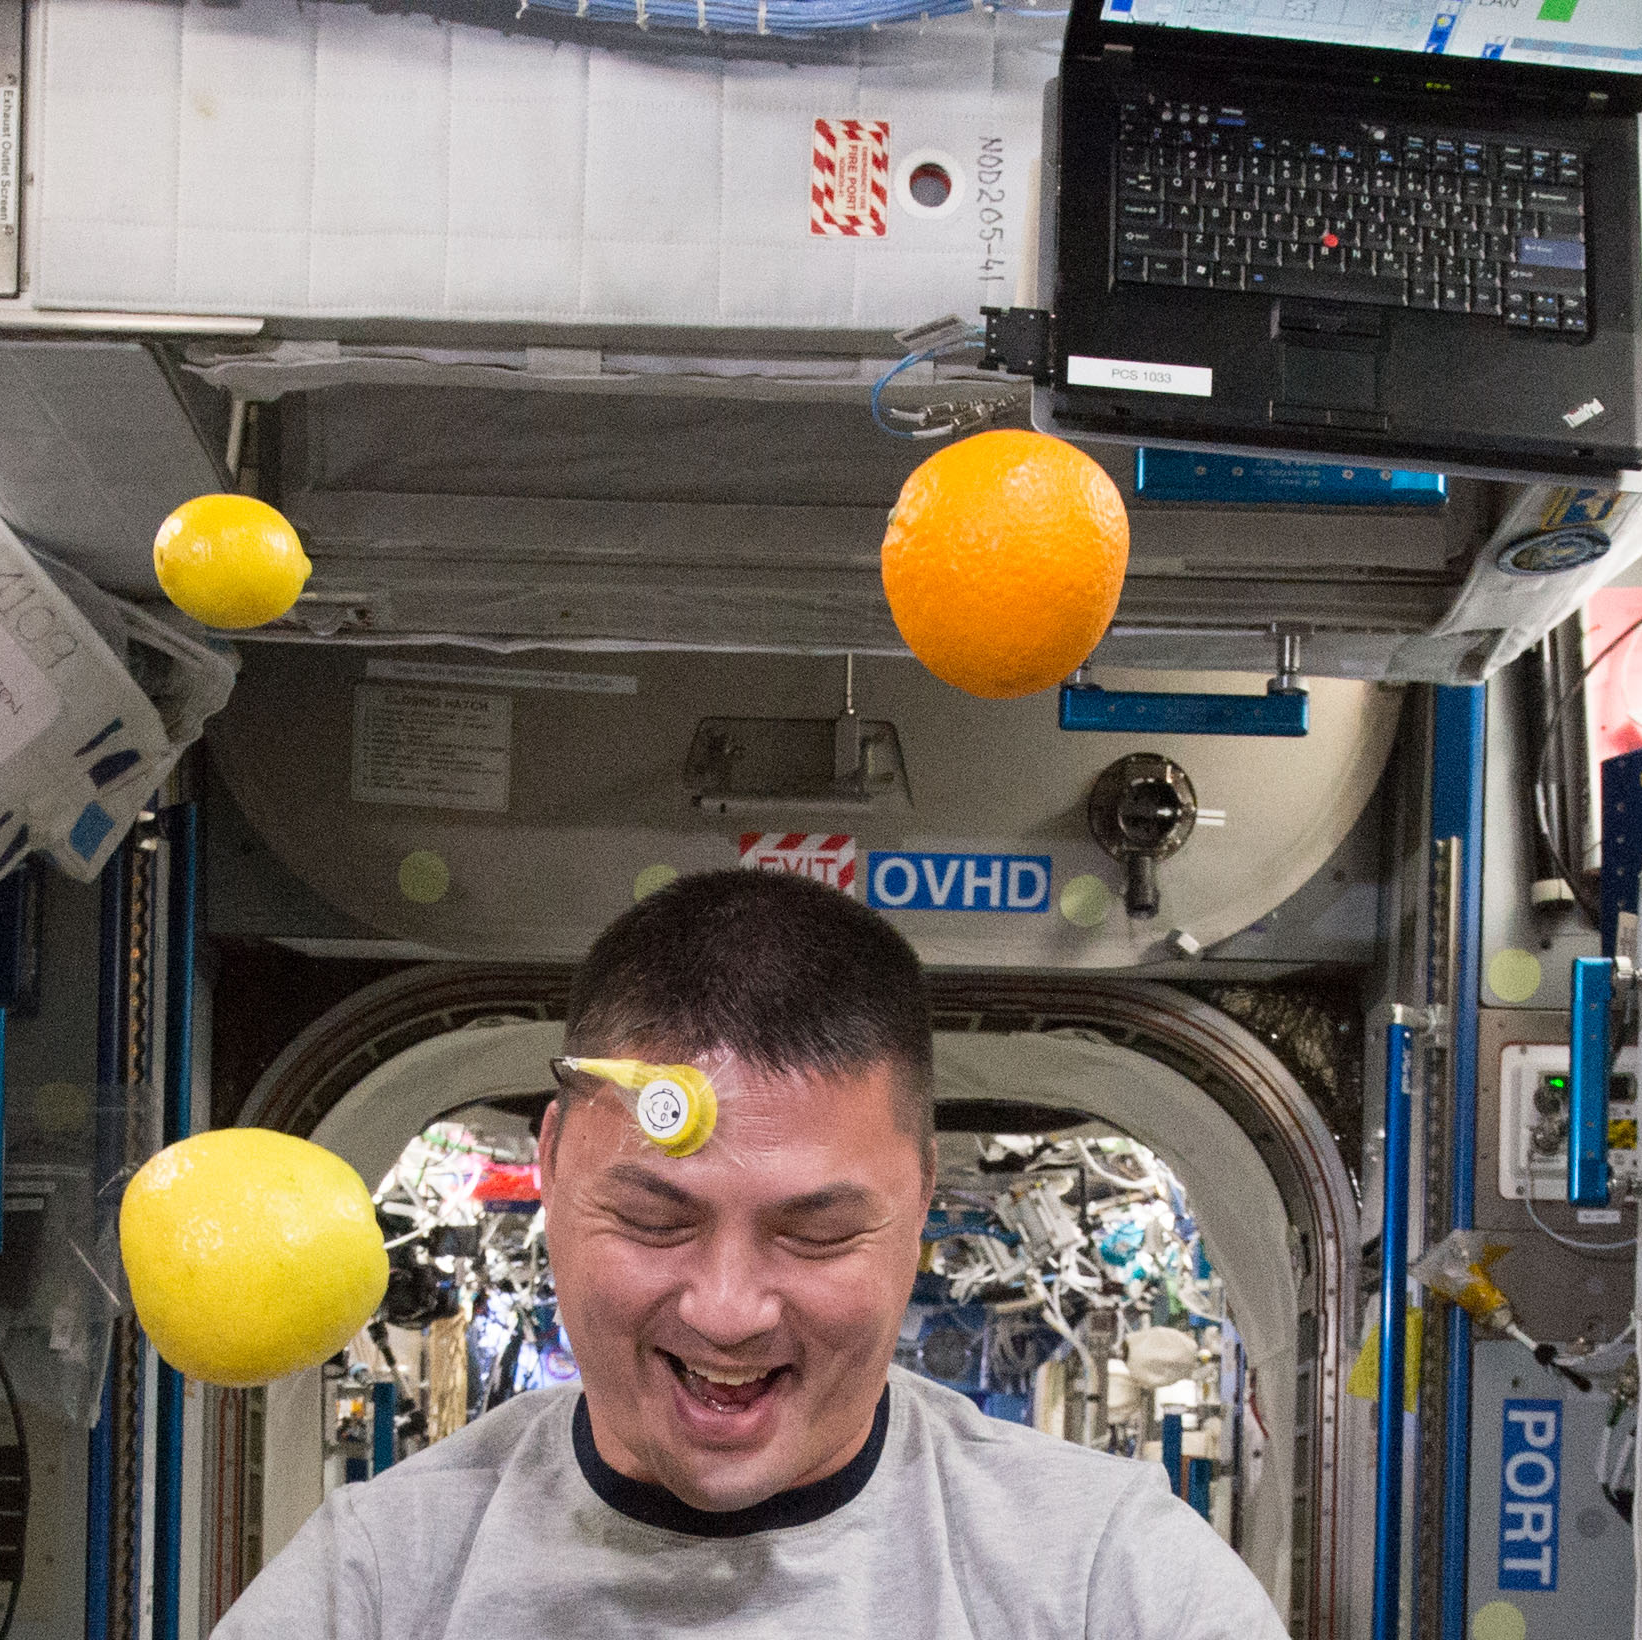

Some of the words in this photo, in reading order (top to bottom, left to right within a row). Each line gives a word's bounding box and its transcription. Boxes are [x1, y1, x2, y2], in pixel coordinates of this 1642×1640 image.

[2, 90, 13, 138] Exhaust
[1, 141, 12, 176] Outlet
[847, 144, 858, 176] FIRE
[0, 180, 11, 221] Screen
[846, 177, 857, 211] PORT
[1111, 368, 1139, 380] PCS
[1144, 371, 1172, 384] 1033
[444, 698, 490, 713] HATCH
[873, 857, 1049, 908] OVHD
[1504, 1407, 1557, 1587] PORT
